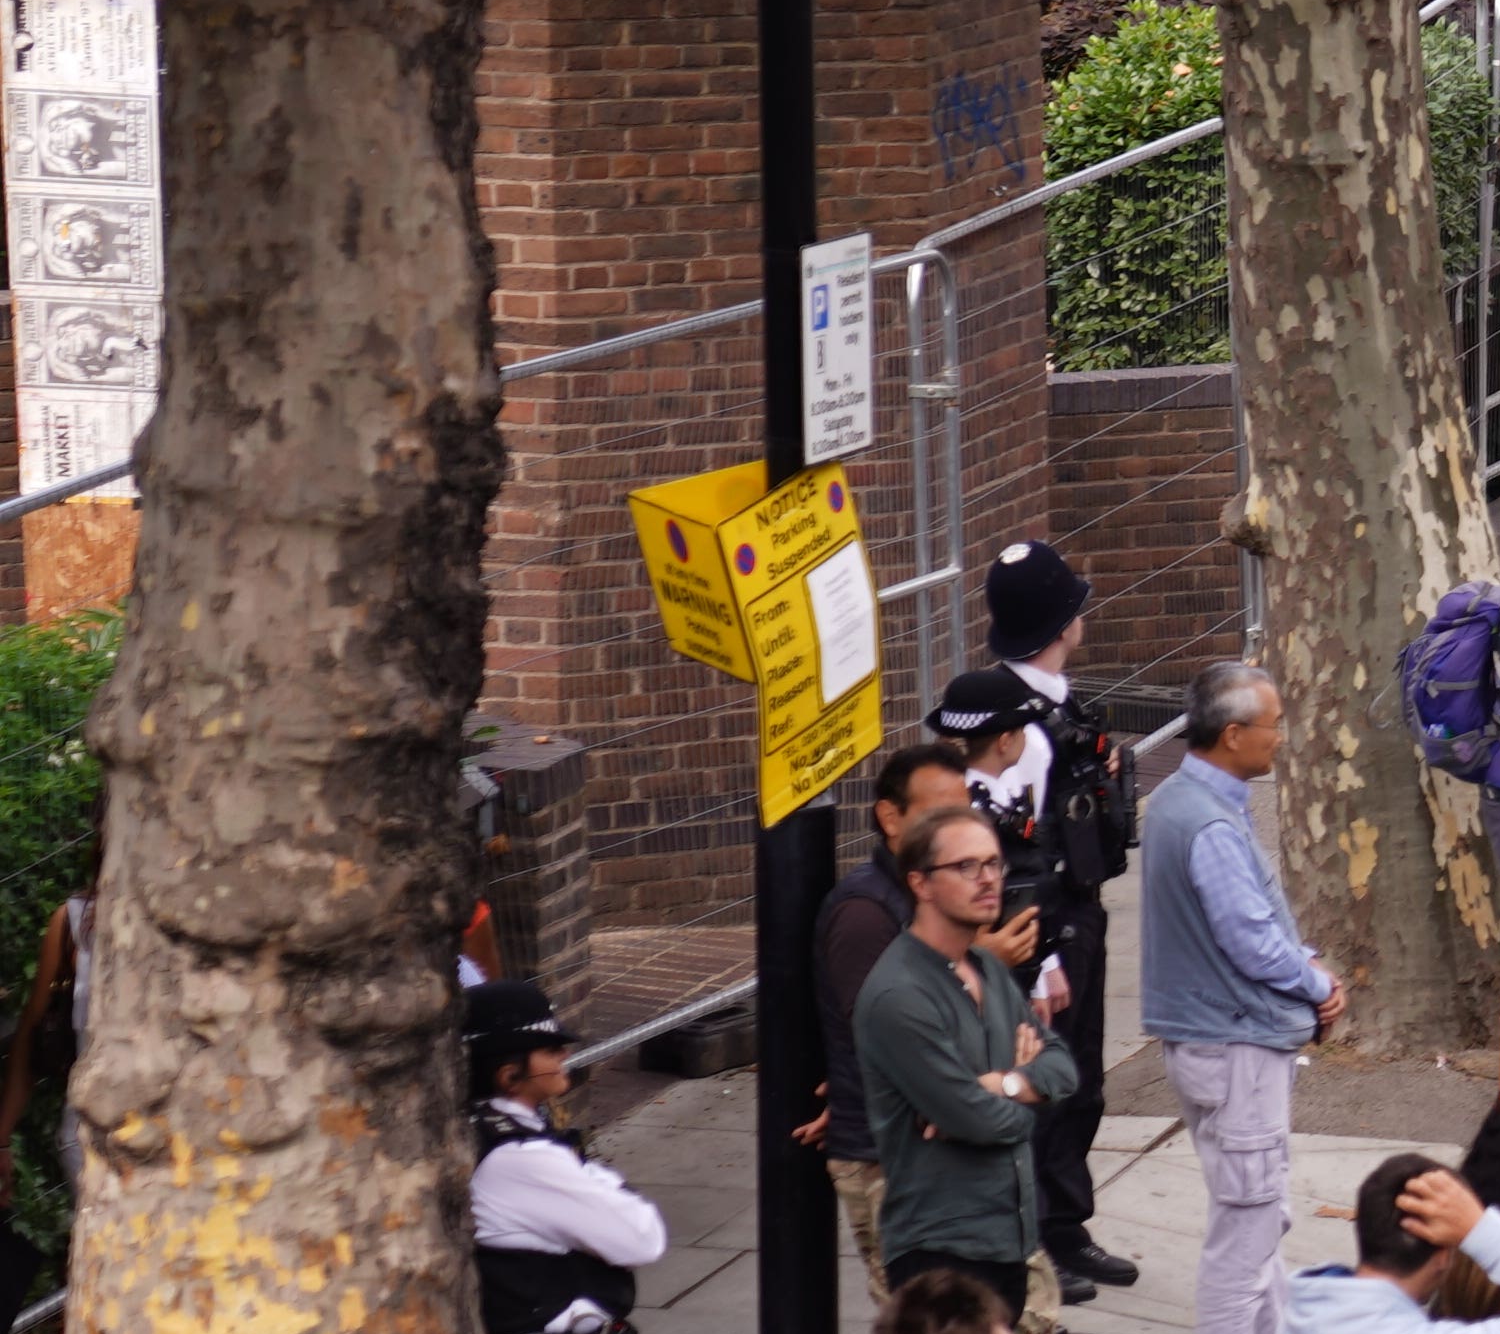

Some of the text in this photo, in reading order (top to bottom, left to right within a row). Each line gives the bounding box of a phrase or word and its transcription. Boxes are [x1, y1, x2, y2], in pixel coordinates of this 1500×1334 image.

[52, 413, 72, 478] MARKET
[755, 475, 819, 528] NOTICE
[771, 513, 818, 547] Parking
[766, 526, 833, 581] Suspended
[659, 577, 733, 627] WARNING
[752, 599, 792, 628] From:
[760, 627, 797, 657] Until:
[767, 674, 818, 714] Reason:
[768, 717, 795, 742] Ref:
[789, 748, 808, 774] No
[791, 743, 856, 796] No loading
